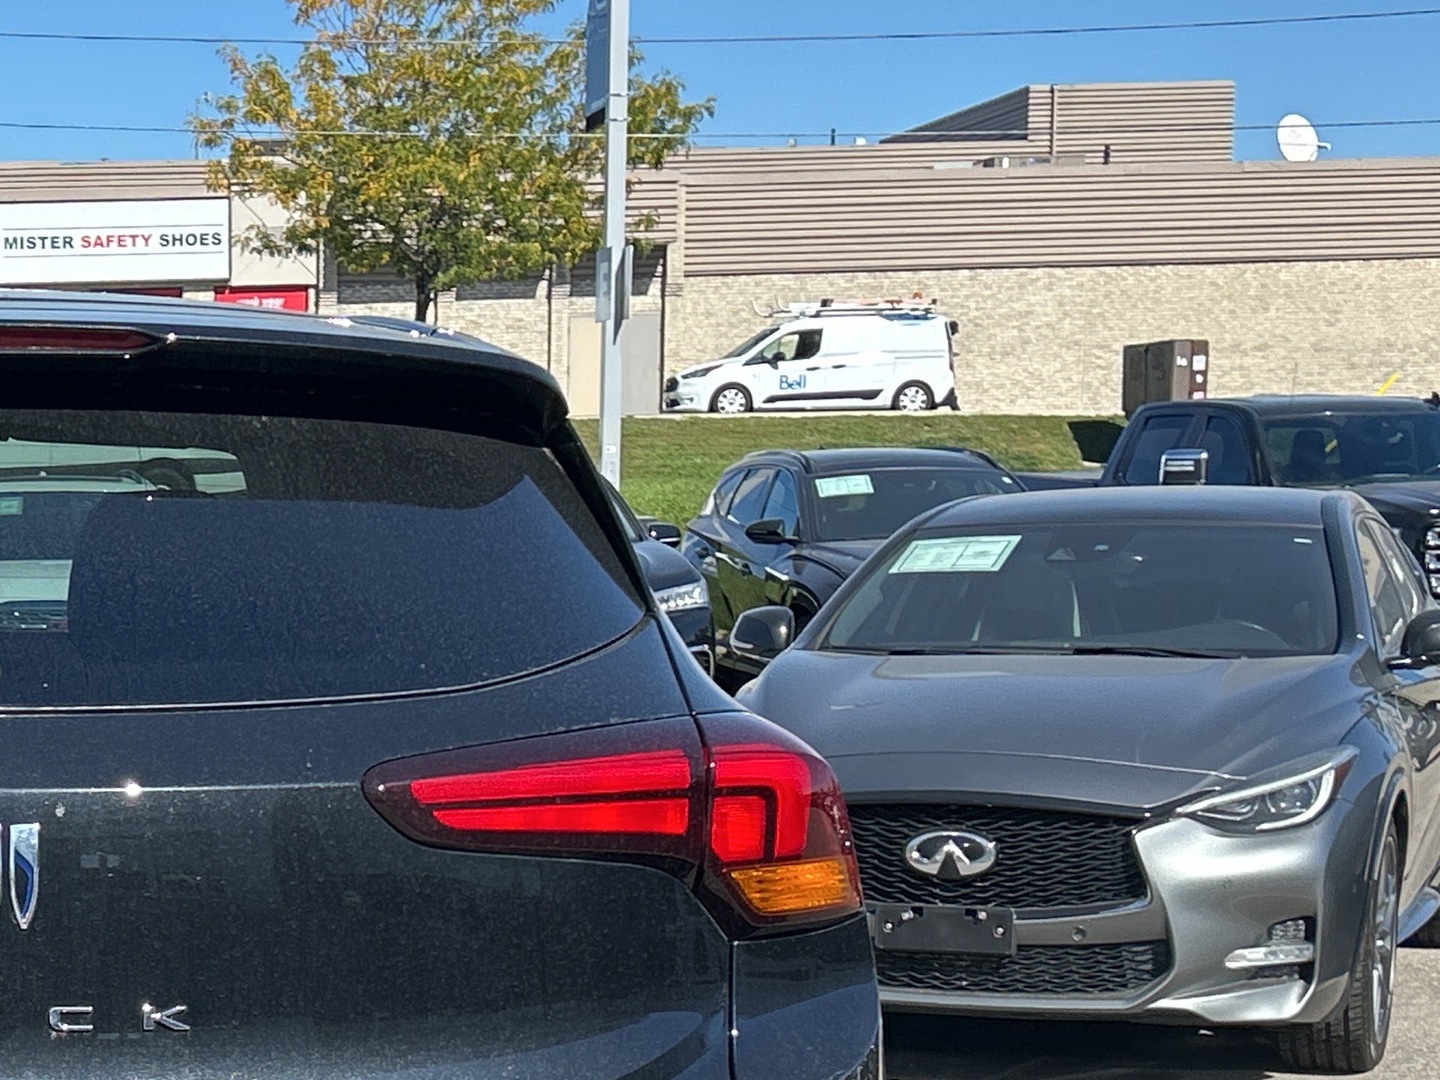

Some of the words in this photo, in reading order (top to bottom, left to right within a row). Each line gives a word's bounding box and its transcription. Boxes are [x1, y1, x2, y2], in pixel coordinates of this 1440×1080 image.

[3, 235, 74, 250] MISTER
[80, 234, 153, 249] SAFETY
[159, 232, 222, 247] SHOES
[779, 374, 806, 390] Bell
